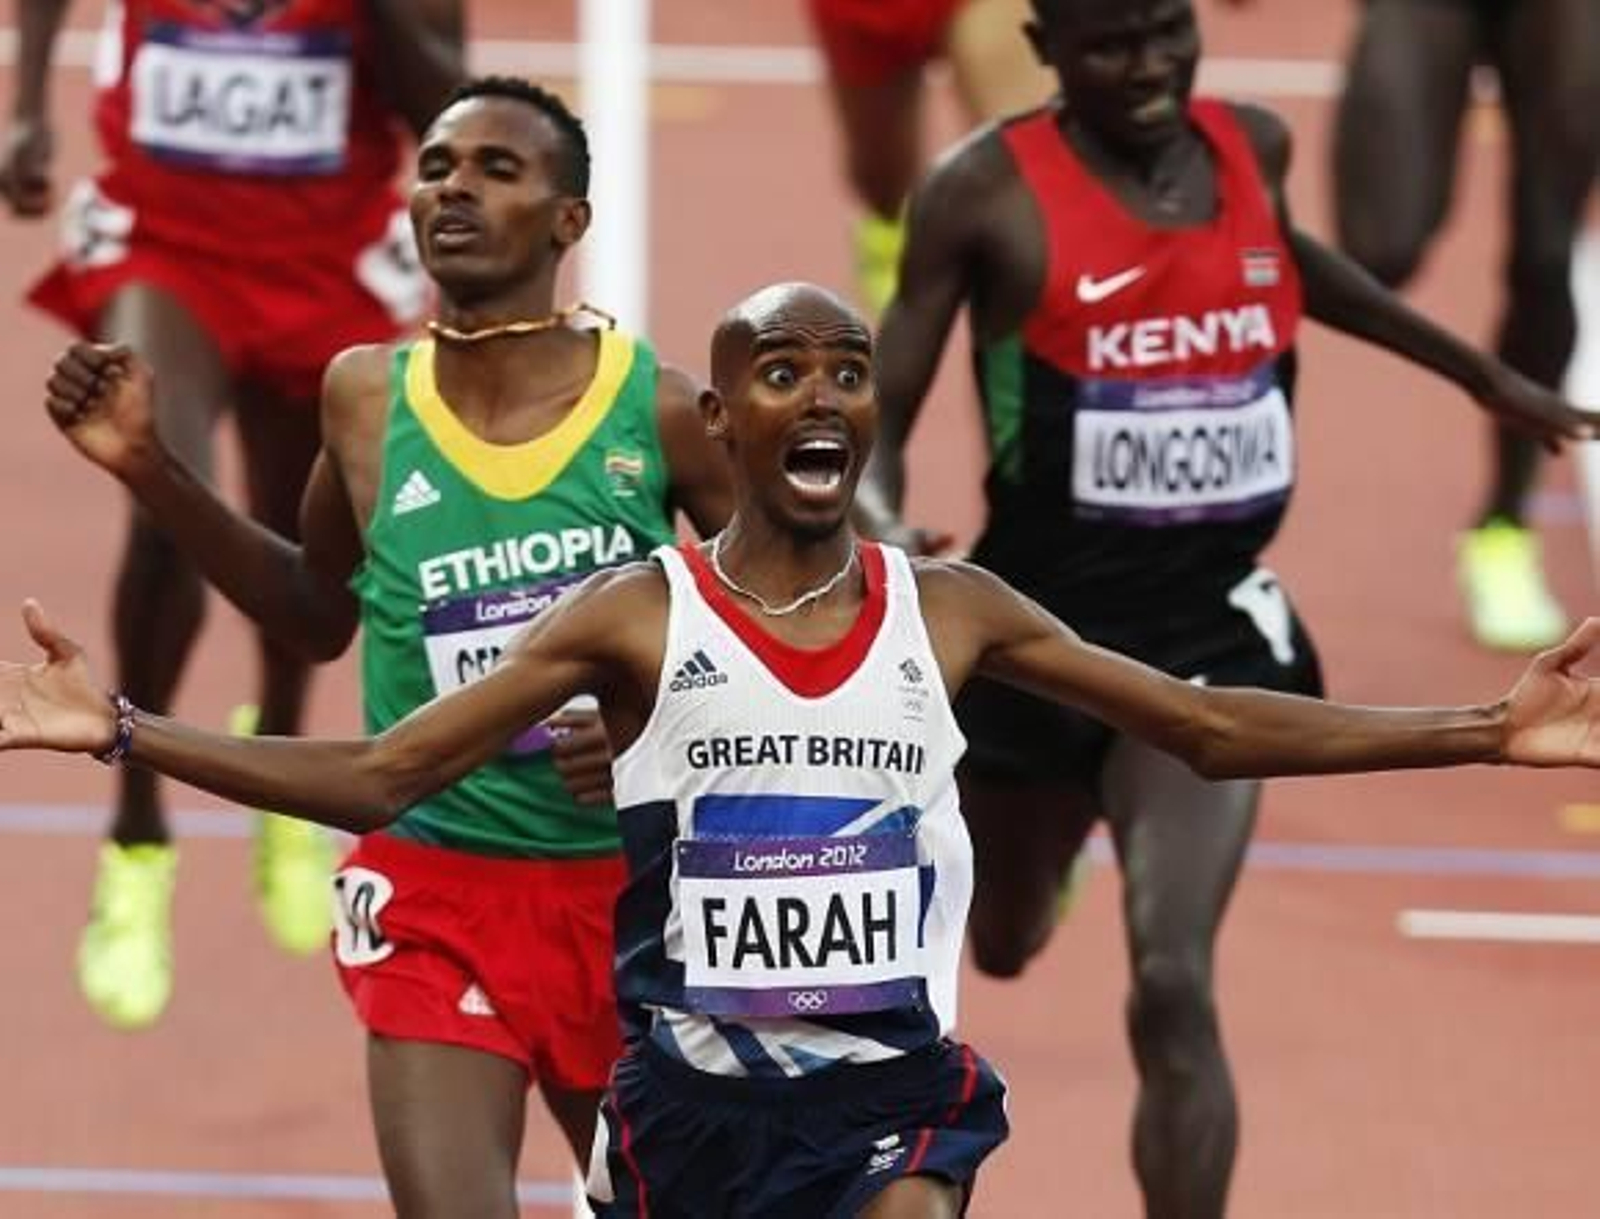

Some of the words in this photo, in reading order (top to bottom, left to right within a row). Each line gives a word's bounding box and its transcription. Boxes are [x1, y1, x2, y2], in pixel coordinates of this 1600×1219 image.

[152, 67, 329, 136] LAGAT
[1087, 304, 1276, 370] KENYA
[418, 524, 635, 600] ETHIOPIA
[669, 672, 728, 692] adidas
[687, 735, 799, 769] GREAT
[734, 847, 814, 871] London
[819, 845, 867, 867] 2012
[702, 889, 896, 970] FARAH
